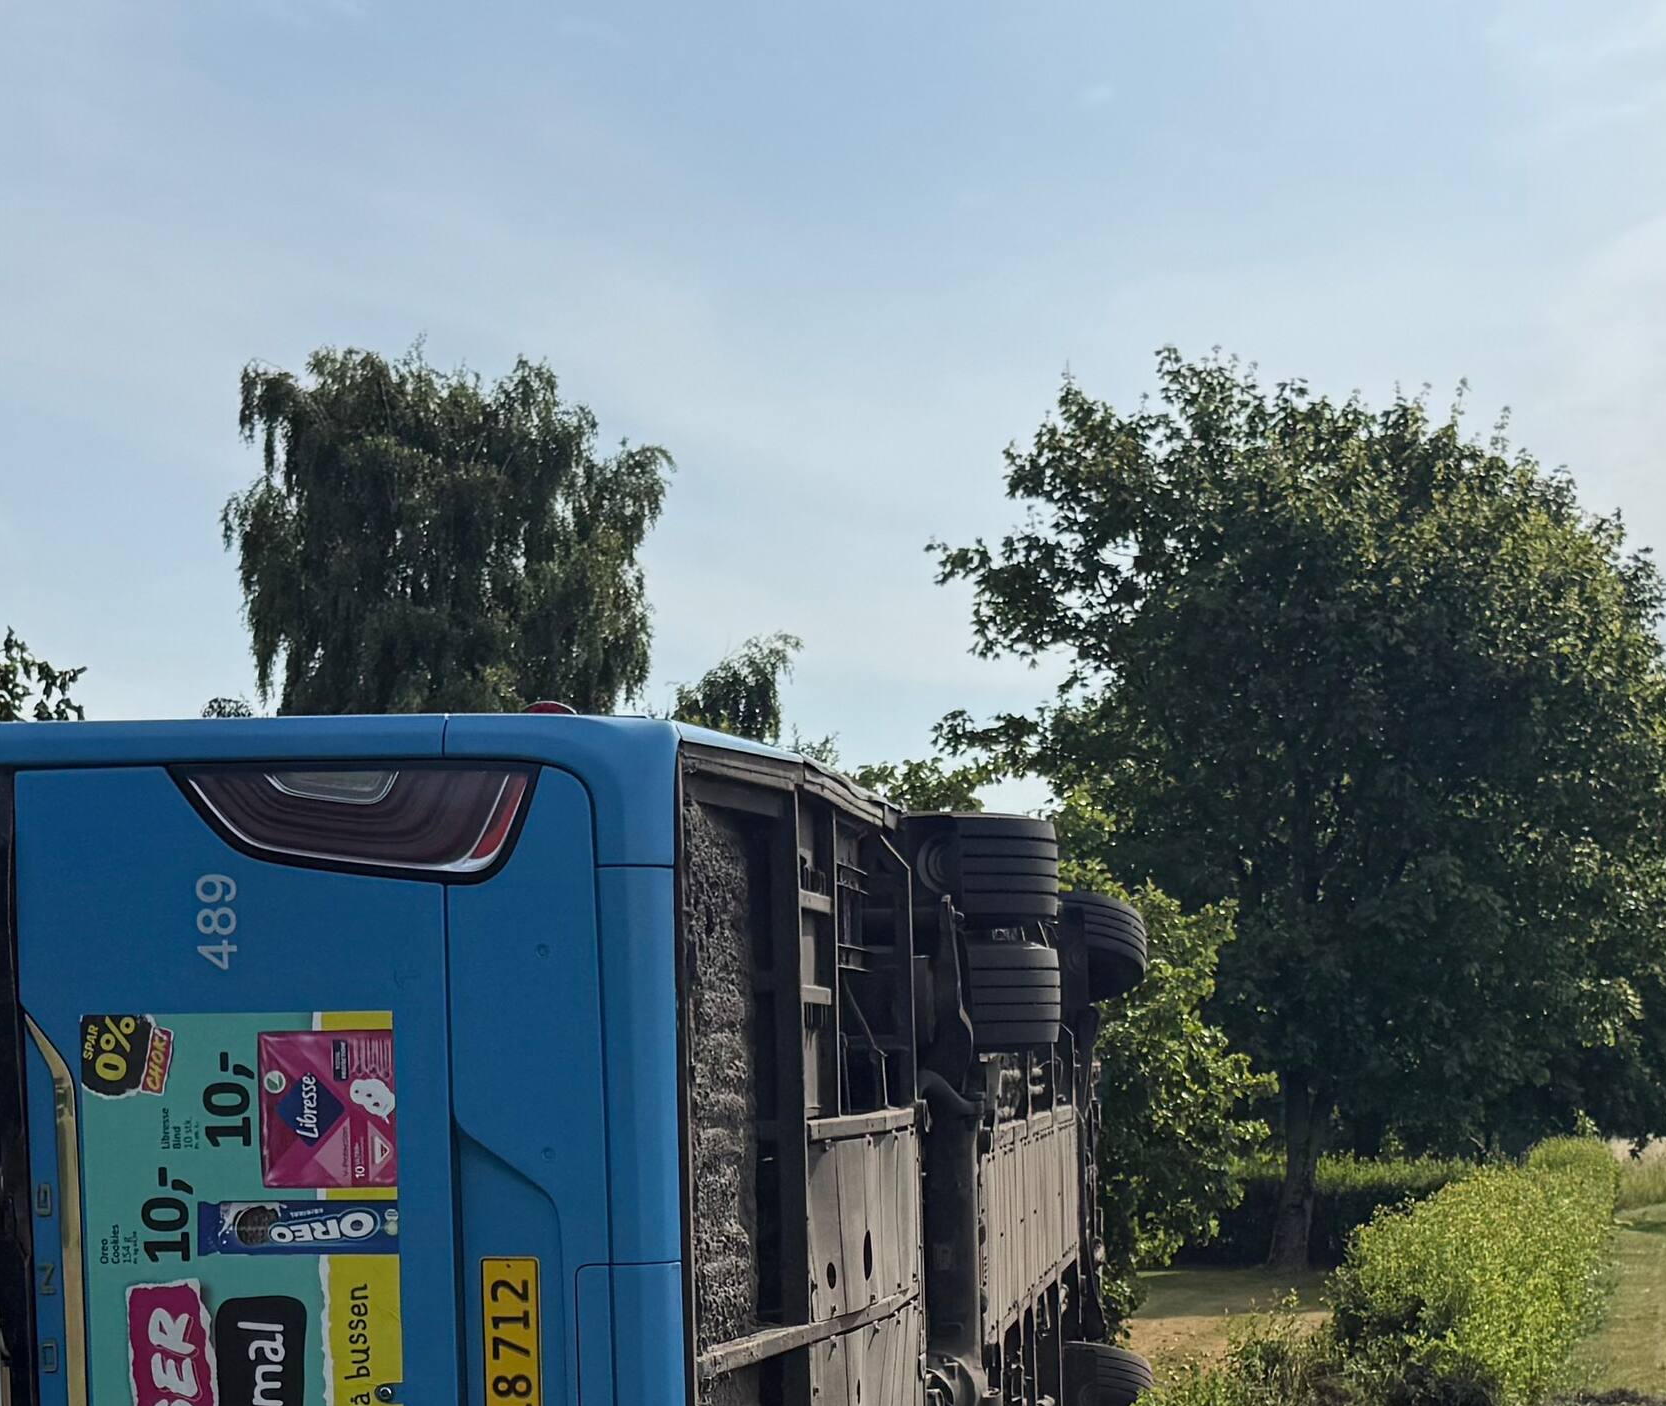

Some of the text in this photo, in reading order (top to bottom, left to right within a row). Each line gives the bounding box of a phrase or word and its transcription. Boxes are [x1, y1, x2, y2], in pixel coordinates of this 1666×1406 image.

[196, 874, 237, 970] 489
[83, 1024, 99, 1060] SPAR
[95, 1015, 136, 1081] 0%
[146, 1028, 168, 1090] CHOK!
[202, 1051, 255, 1147] 10,-
[295, 1074, 319, 1139] Libresse
[162, 1107, 171, 1150] Libresse
[173, 1126, 182, 1150] Bind
[354, 1165, 365, 1179] 10
[141, 1166, 193, 1262] 10,-
[270, 1211, 375, 1243] OREO
[100, 1238, 109, 1265] Oreo
[110, 1223, 121, 1265] Cookies
[122, 1245, 132, 1263] 154
[344, 1283, 371, 1381] bussen
[490, 1278, 531, 1361] 712
